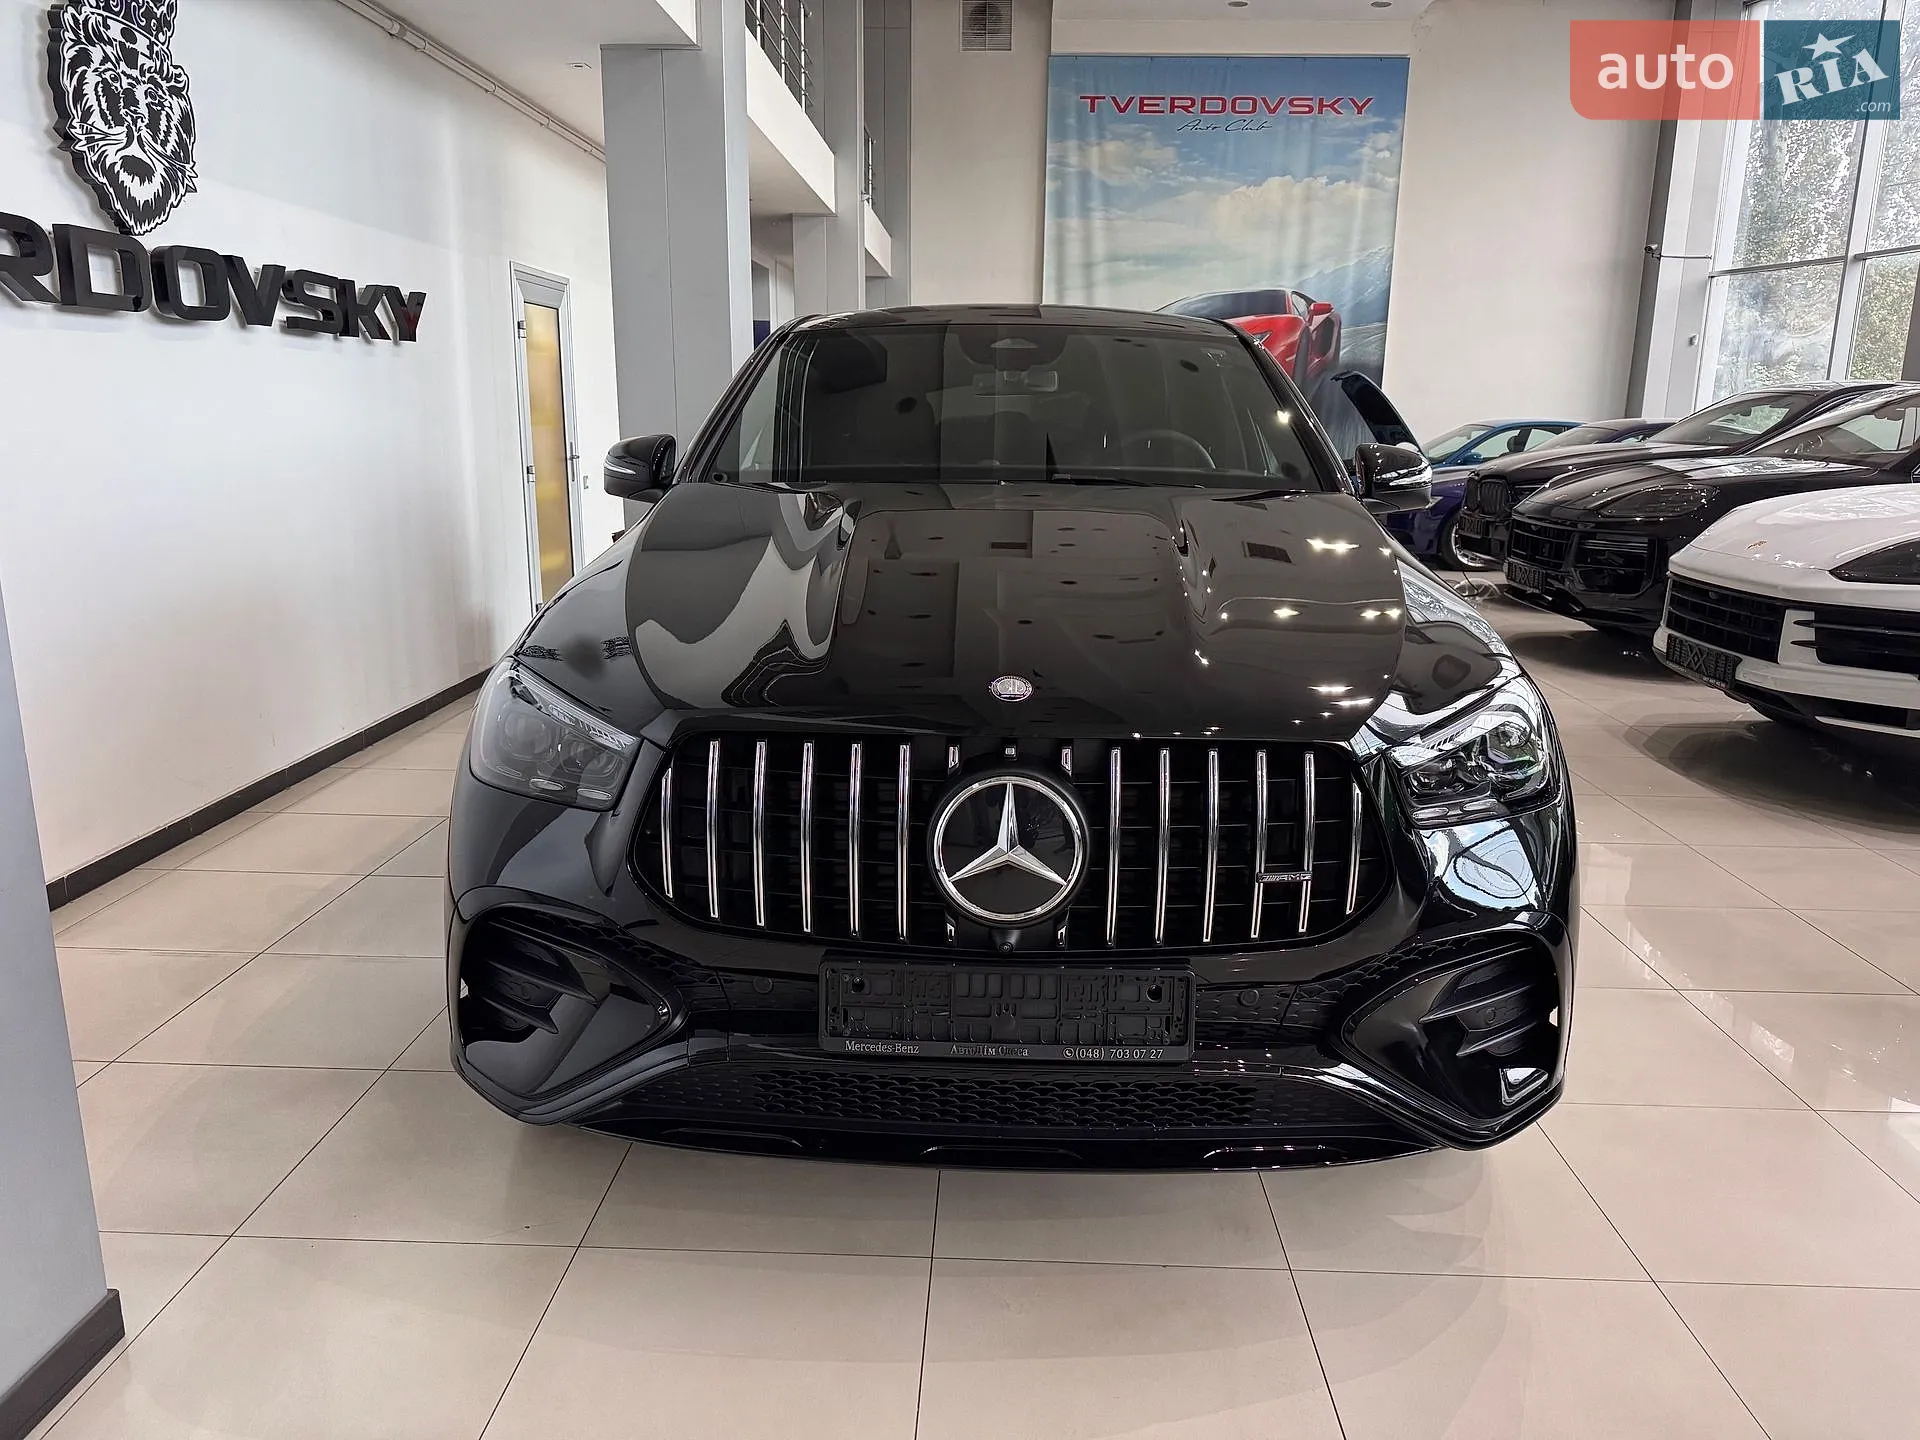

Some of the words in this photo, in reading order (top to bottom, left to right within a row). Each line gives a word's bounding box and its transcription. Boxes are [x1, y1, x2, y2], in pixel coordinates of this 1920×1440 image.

[1080, 95, 1374, 116] TVERDOVSKY
[1177, 119, 1220, 131] Auto
[1225, 119, 1272, 132] Club
[845, 1040, 920, 1054] Mercedes-Benz
[1075, 1047, 1105, 1059] (048)
[1109, 1049, 1130, 1059] 703
[1133, 1049, 1146, 1059] 07
[1150, 1049, 1163, 1059] 27
